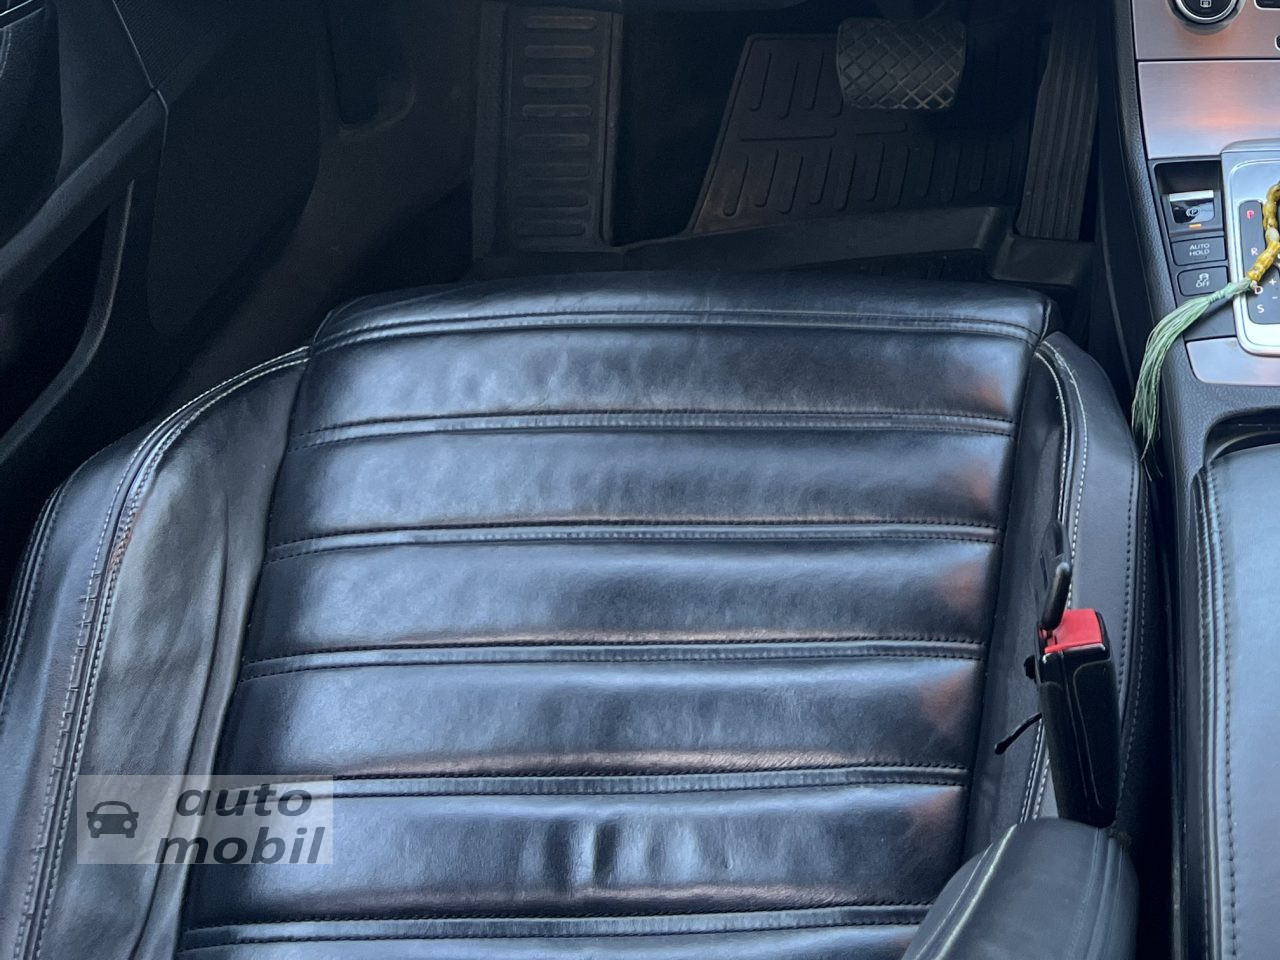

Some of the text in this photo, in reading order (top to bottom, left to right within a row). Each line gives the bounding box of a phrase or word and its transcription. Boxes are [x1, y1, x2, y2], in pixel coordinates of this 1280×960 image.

[1246, 210, 1255, 220] P
[1251, 247, 1258, 256] R
[1196, 280, 1210, 288] OFF
[1254, 285, 1263, 295] D
[1257, 304, 1265, 313] S
